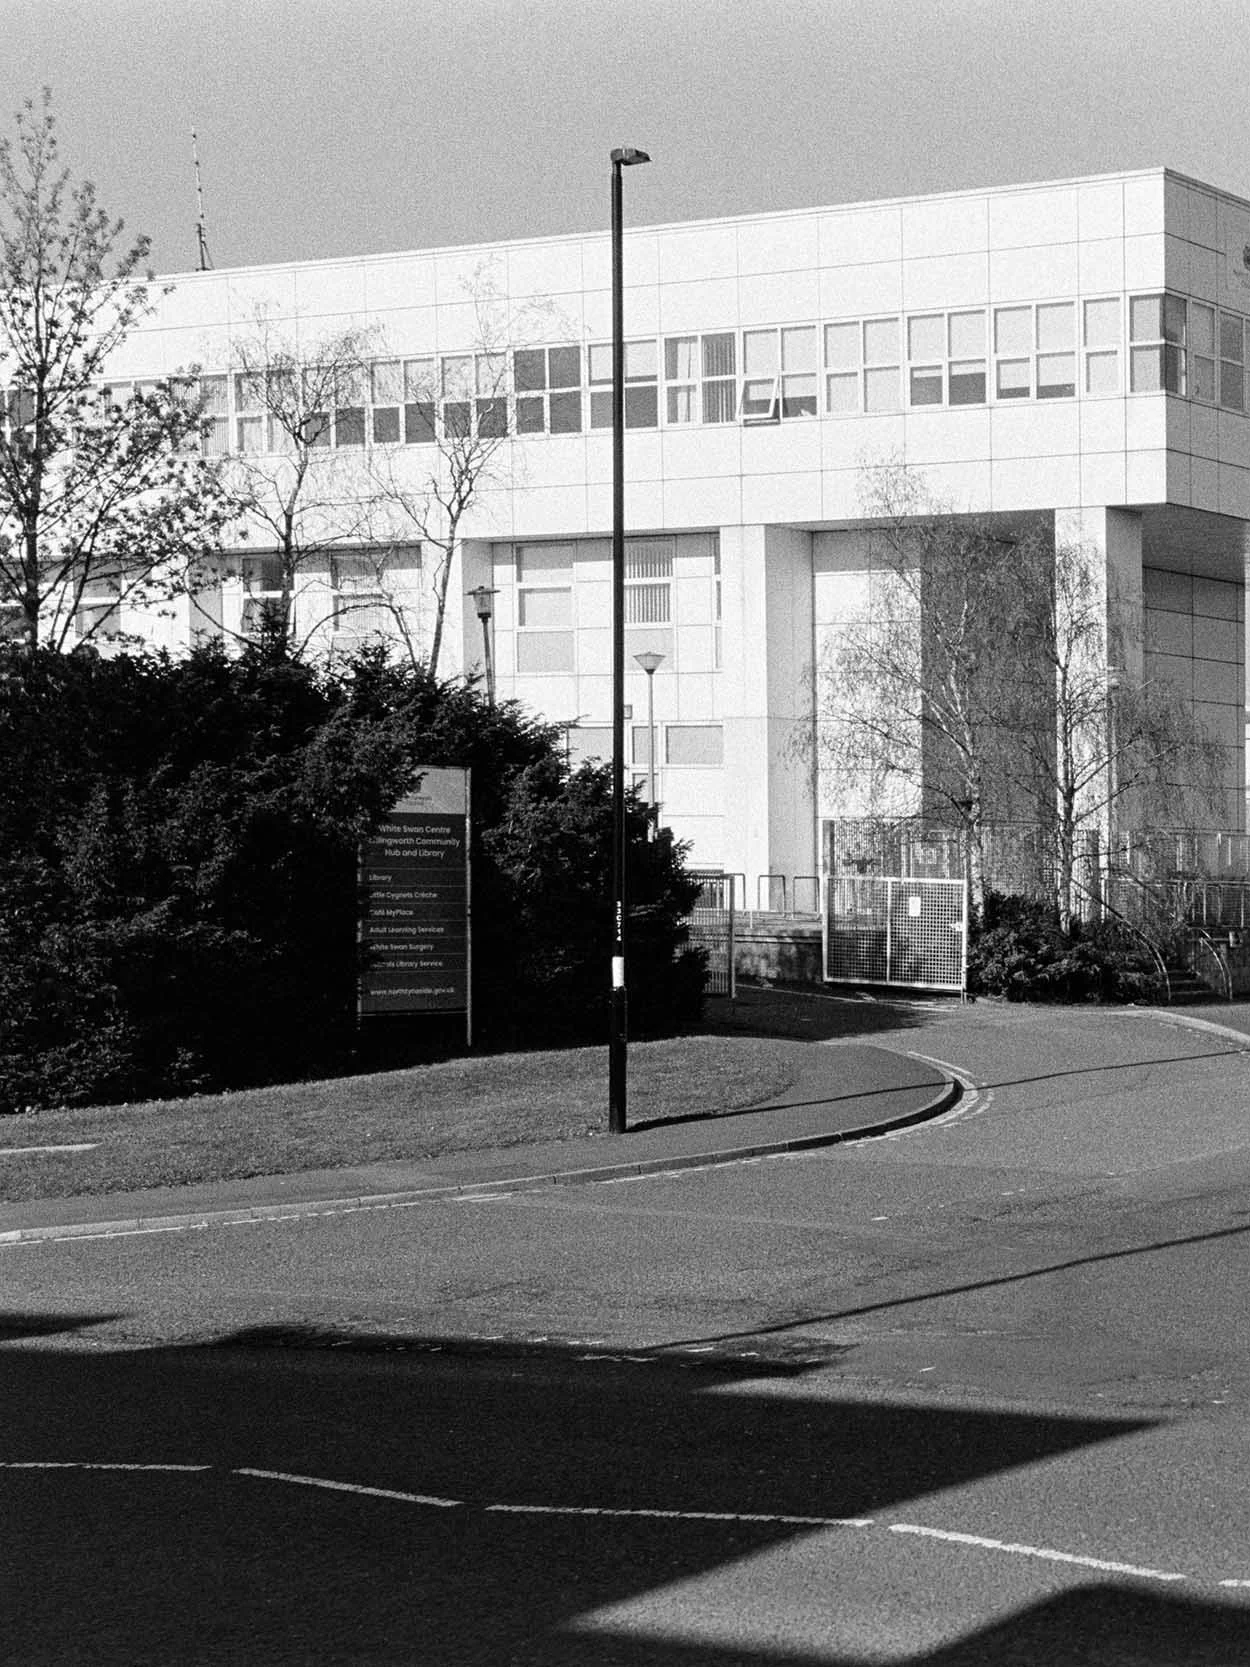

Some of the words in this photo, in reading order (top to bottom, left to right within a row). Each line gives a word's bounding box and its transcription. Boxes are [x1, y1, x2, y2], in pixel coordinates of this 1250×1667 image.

[378, 824, 401, 833] White
[402, 825, 424, 833] Swan
[425, 825, 451, 834] Centre
[415, 838, 461, 848] Community
[384, 849, 401, 857] Hub
[402, 849, 418, 857] and
[418, 849, 445, 860] Library
[369, 873, 392, 882] Library
